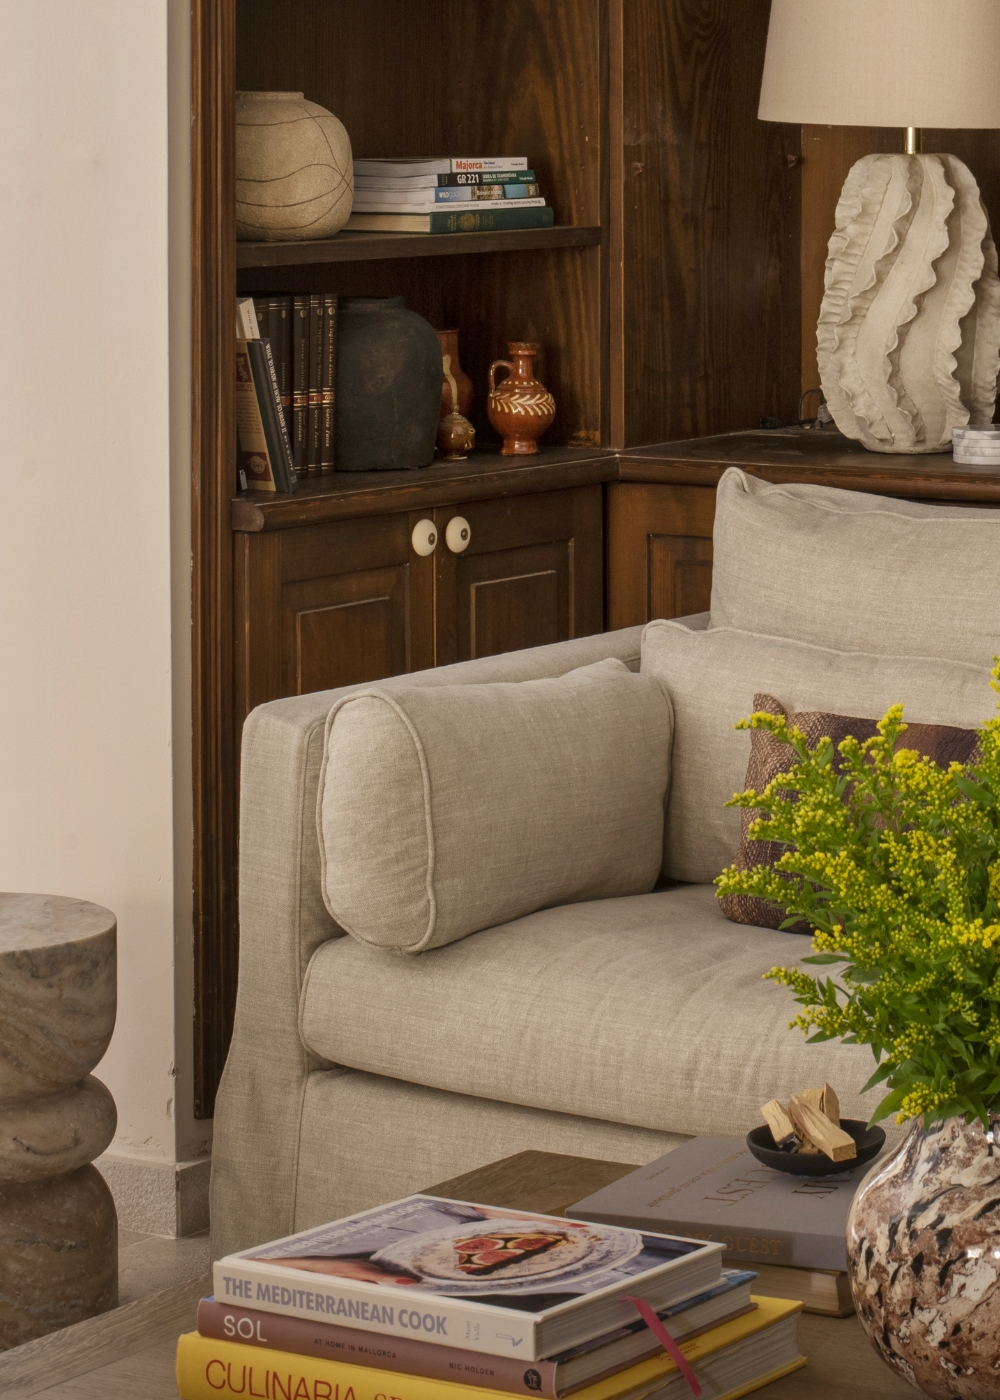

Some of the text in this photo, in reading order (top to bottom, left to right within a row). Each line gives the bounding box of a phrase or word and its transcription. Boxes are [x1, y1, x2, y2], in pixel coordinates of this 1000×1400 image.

[456, 160, 483, 172] Majorca
[457, 174, 466, 184] GR
[467, 174, 479, 183] 221
[276, 403, 282, 411] TO
[258, 1248, 288, 1260] THE
[389, 1201, 433, 1216] COOK
[720, 1235, 784, 1255] GUEST
[223, 1276, 448, 1335] THE MEDITERRANEAN COOK
[223, 1315, 267, 1342] SOL
[325, 1340, 346, 1350] HOME
[358, 1346, 397, 1358] MALLORCA
[449, 1362, 494, 1376] NIC HOLDEN
